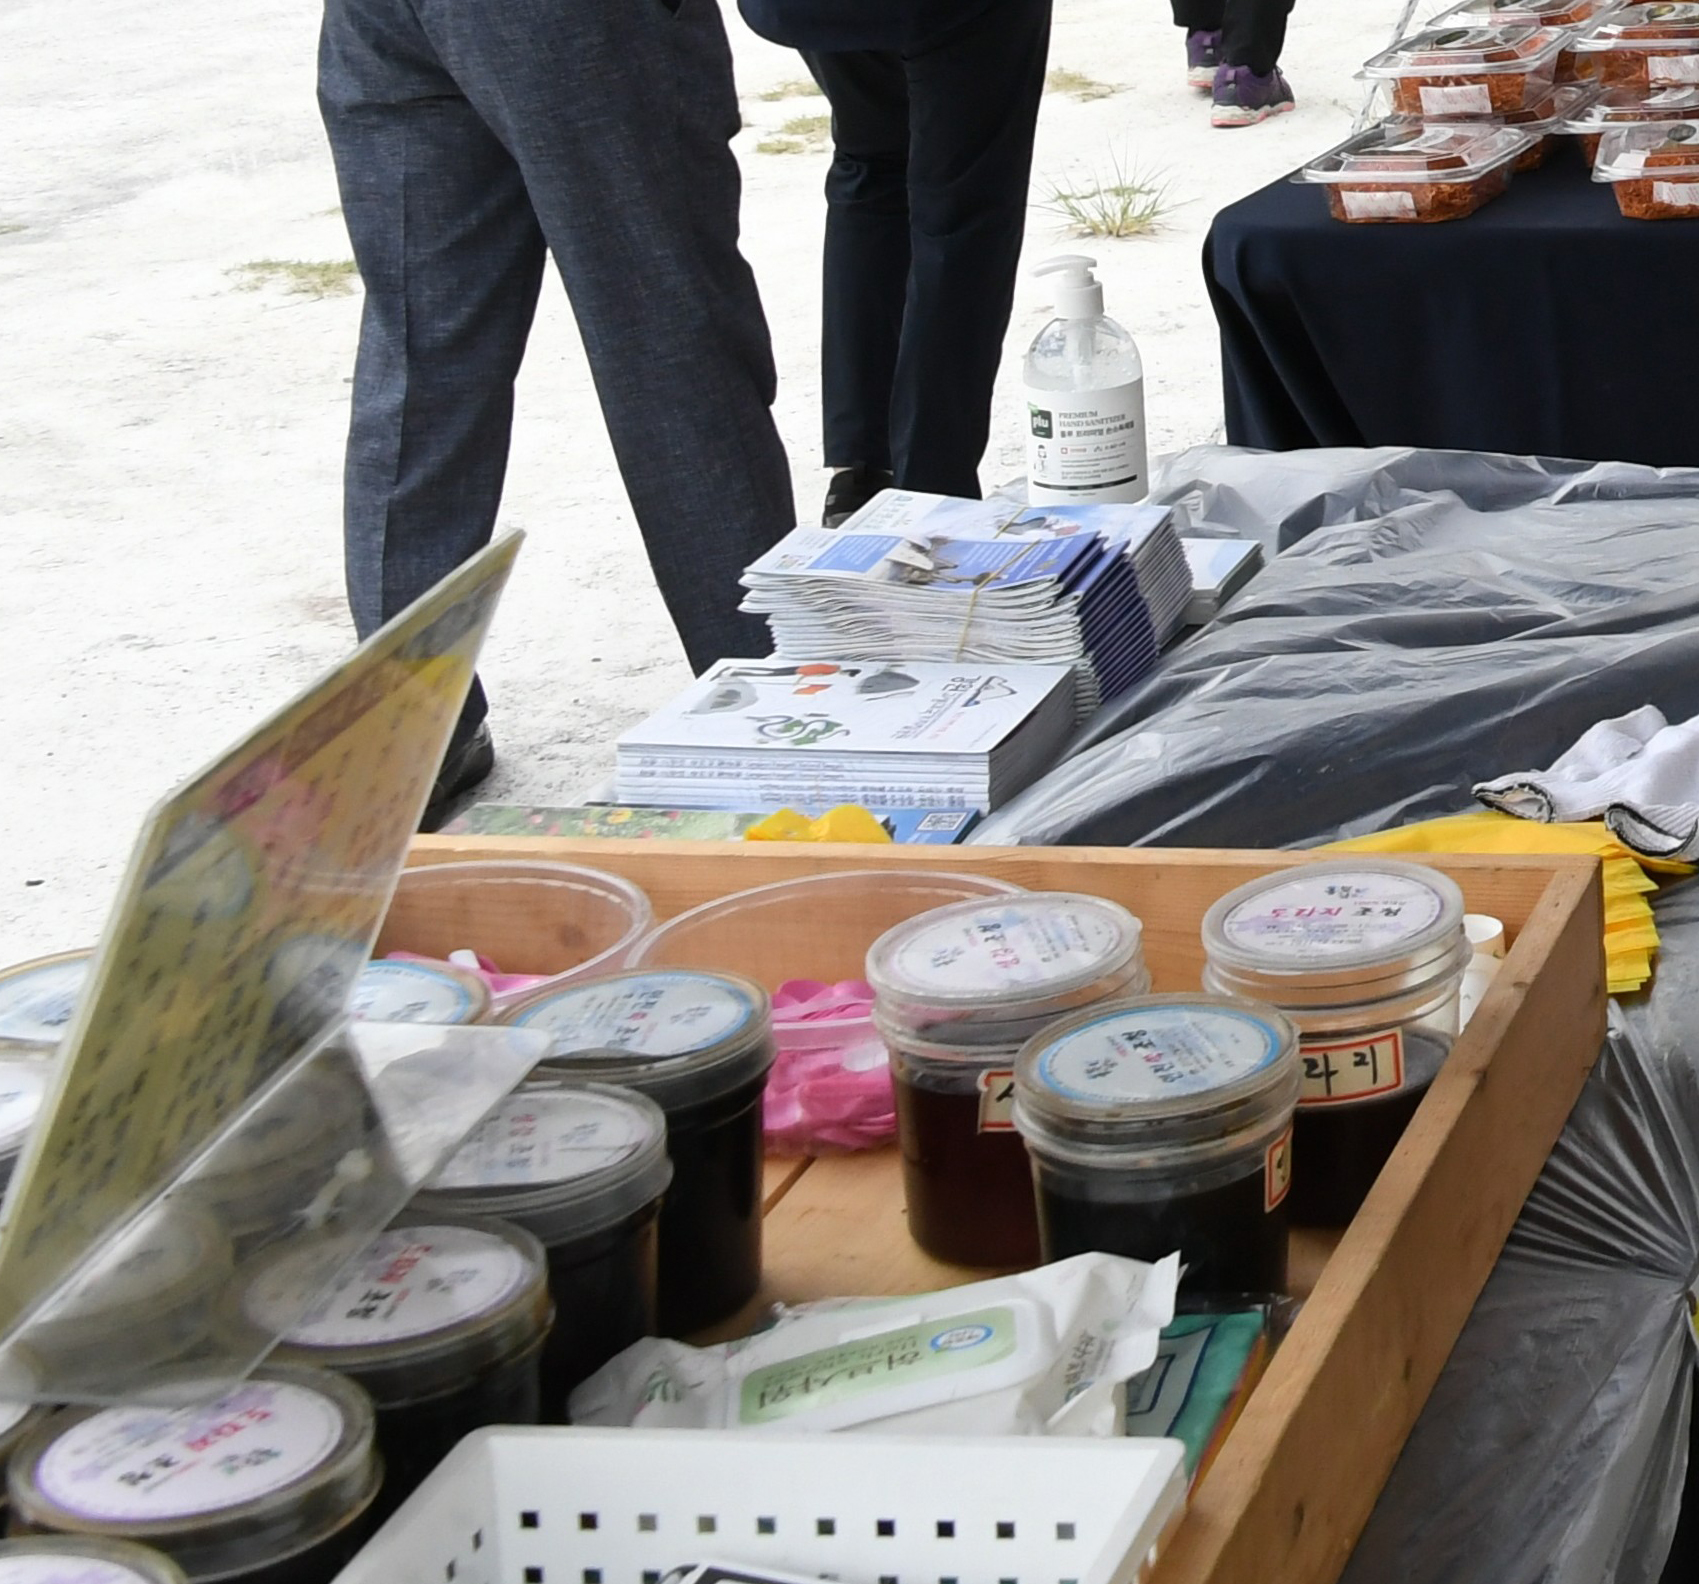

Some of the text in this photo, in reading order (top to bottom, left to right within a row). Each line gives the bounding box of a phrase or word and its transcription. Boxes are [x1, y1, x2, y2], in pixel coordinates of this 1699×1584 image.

[1058, 410, 1098, 419] PREMIUM
[1085, 414, 1126, 427] SANITIZER
[1032, 414, 1050, 429] plu
